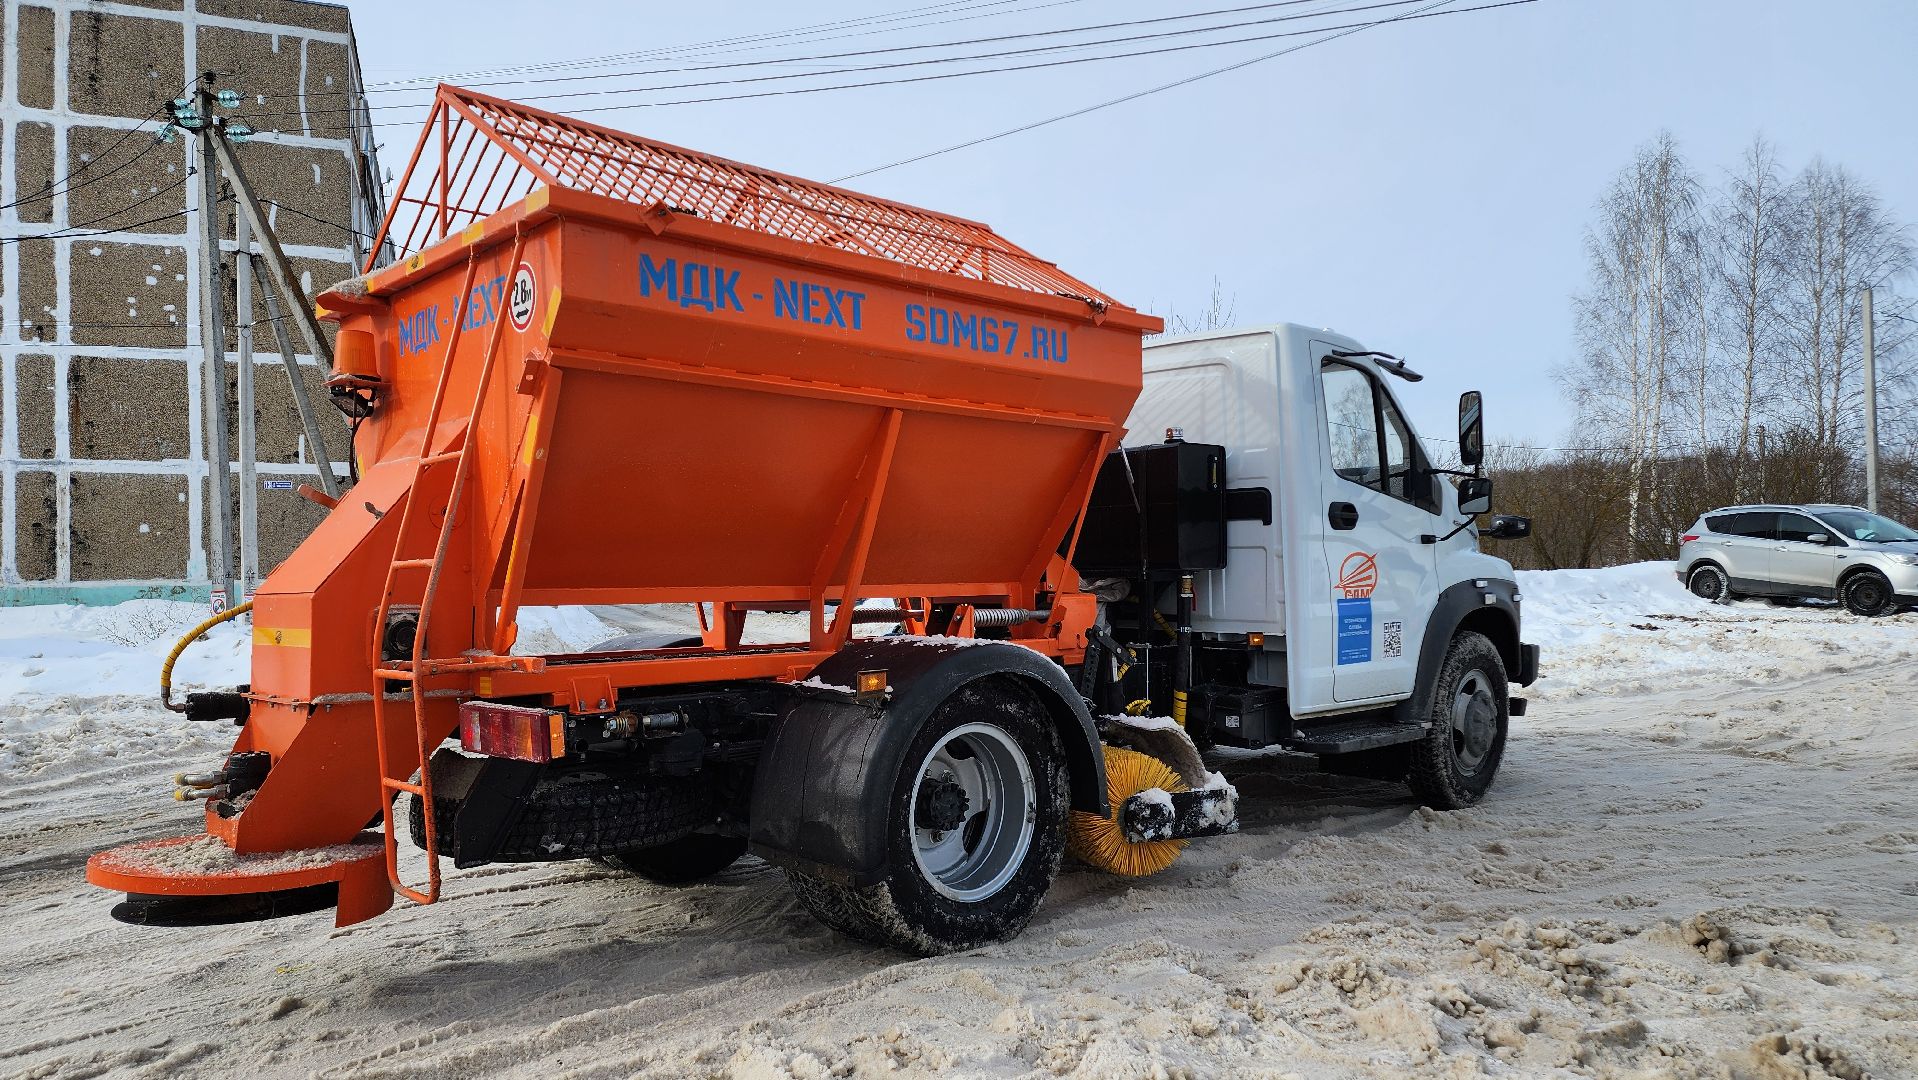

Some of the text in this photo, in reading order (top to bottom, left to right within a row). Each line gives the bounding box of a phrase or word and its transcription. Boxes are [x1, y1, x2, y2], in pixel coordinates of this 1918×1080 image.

[398, 304, 440, 357] МДК
[640, 253, 744, 313] МДК
[773, 278, 866, 330] NEXT
[905, 303, 1068, 363] SDM67.RU
